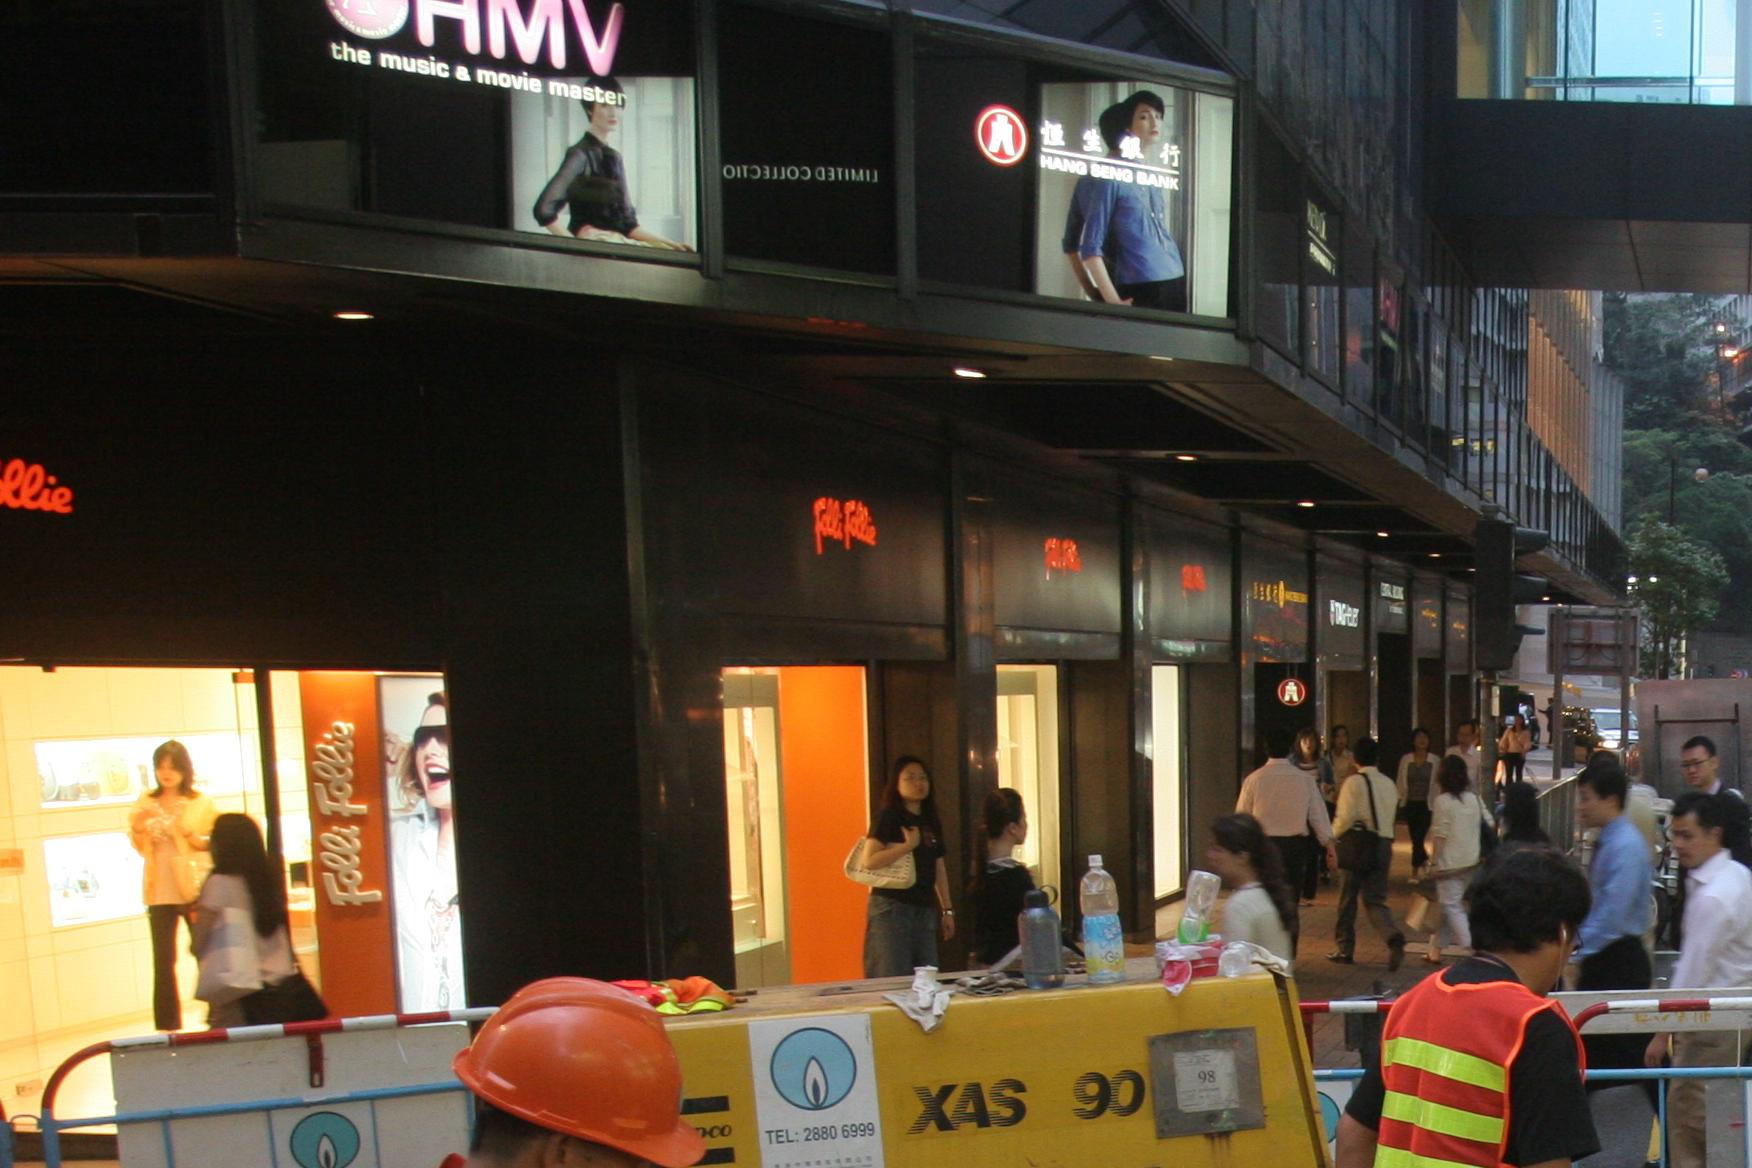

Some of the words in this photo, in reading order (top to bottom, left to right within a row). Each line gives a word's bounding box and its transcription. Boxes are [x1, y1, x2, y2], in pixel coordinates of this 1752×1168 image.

[331, 41, 371, 65] the
[379, 52, 450, 79] music
[456, 66, 471, 82] &
[477, 67, 542, 93] movie
[549, 80, 627, 106] master
[1040, 155, 1087, 176] HANG
[1090, 163, 1133, 183] SENG
[1137, 170, 1179, 190] BANK
[0, 458, 73, 513] llie
[312, 721, 368, 817] Follie
[320, 825, 383, 906] Folli
[907, 1079, 1028, 1135] XAS
[1072, 1069, 1146, 1120] 90
[1198, 1070, 1216, 1084] 98
[765, 1129, 799, 1145] TEL:
[803, 1125, 838, 1142] 2880
[841, 1122, 875, 1138] 6999
